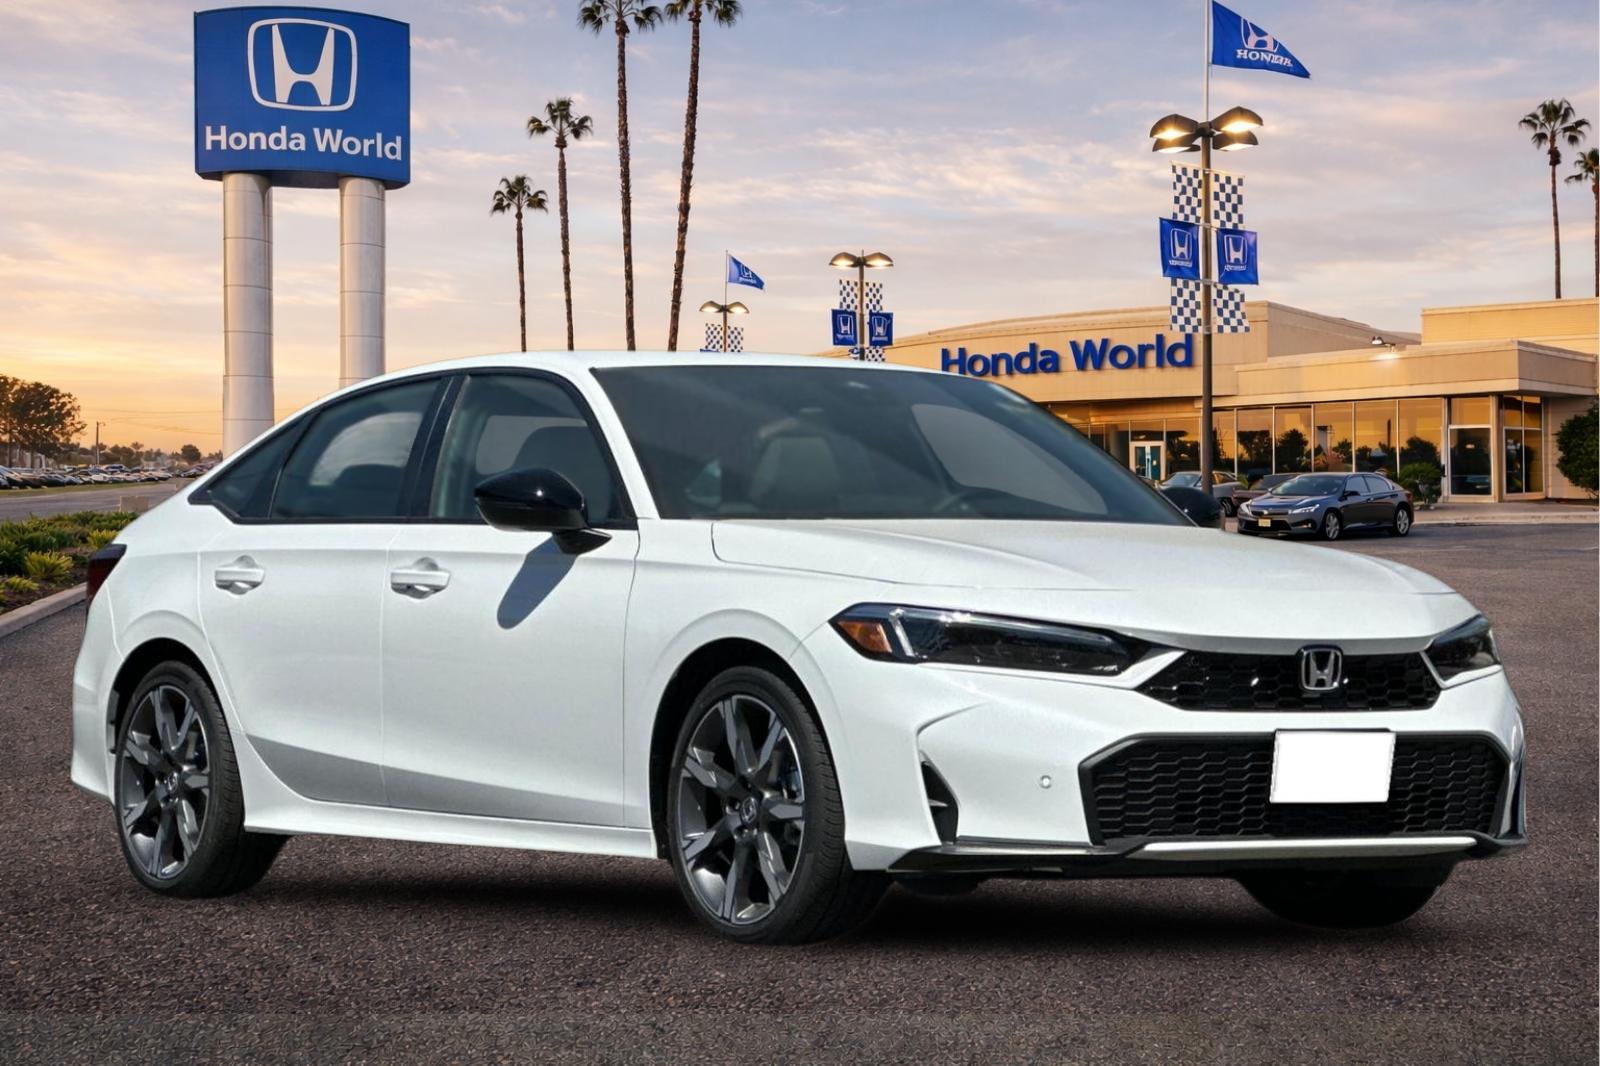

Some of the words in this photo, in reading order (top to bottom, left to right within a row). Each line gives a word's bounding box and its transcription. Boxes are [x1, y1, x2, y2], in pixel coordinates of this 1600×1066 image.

[205, 125, 306, 151] Honda
[313, 127, 402, 160] World
[941, 343, 1060, 377] Honda
[1069, 332, 1195, 371] World
